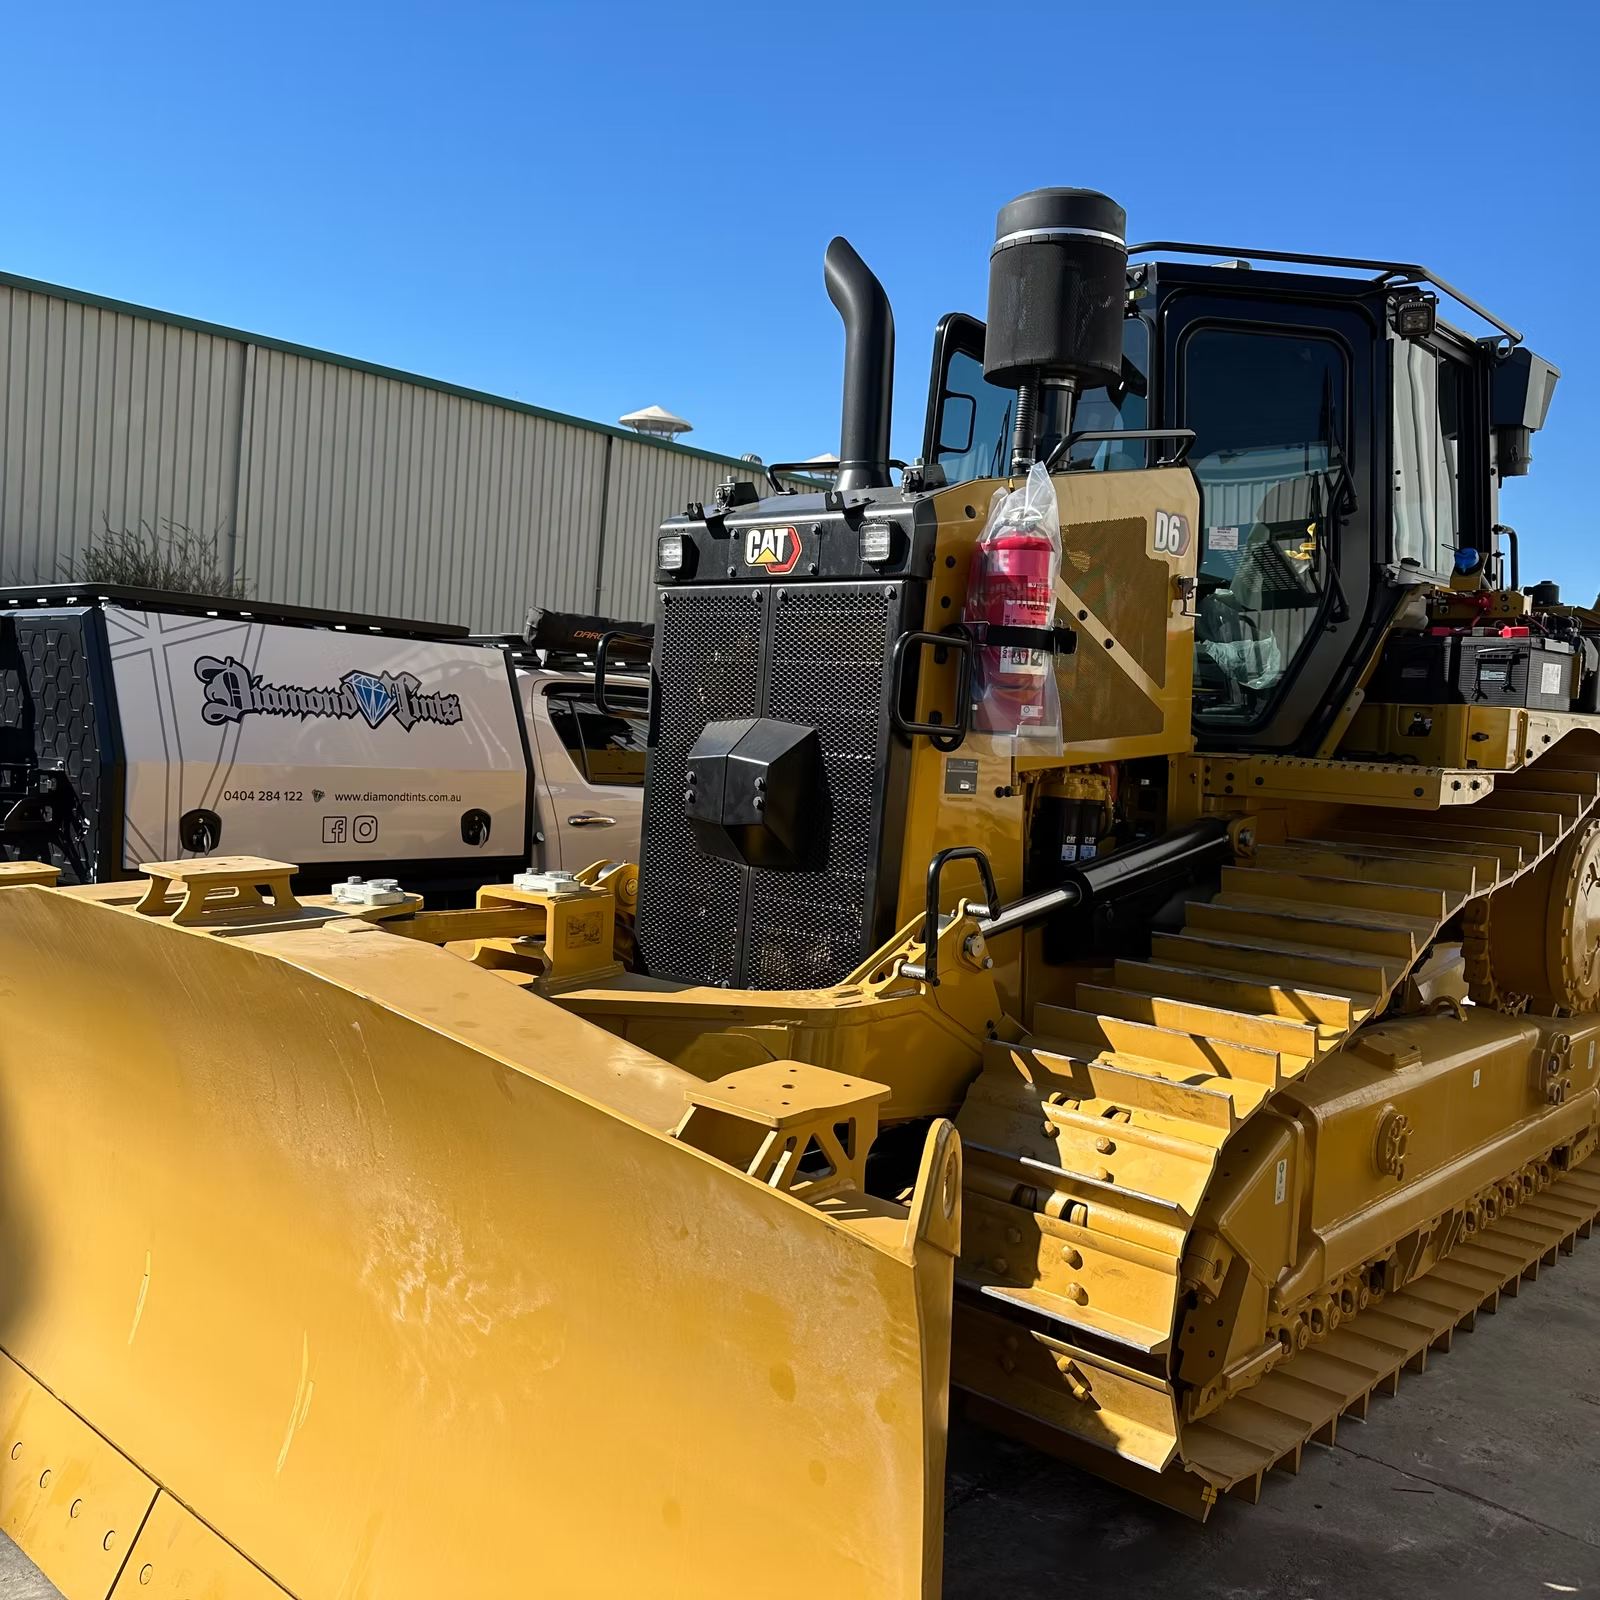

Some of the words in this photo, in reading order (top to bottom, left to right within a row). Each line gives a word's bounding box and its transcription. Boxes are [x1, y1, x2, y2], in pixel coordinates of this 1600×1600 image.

[1154, 511, 1181, 552] D6
[746, 528, 789, 564] CAT
[193, 655, 360, 726] Diamond
[378, 670, 463, 733] Tints
[223, 790, 255, 802] 0404
[258, 790, 281, 802] 284
[283, 791, 303, 802] 122
[334, 791, 462, 802] www.diamondtints.com.au
[1066, 835, 1077, 844] CAT
[1084, 836, 1096, 844] CAT
